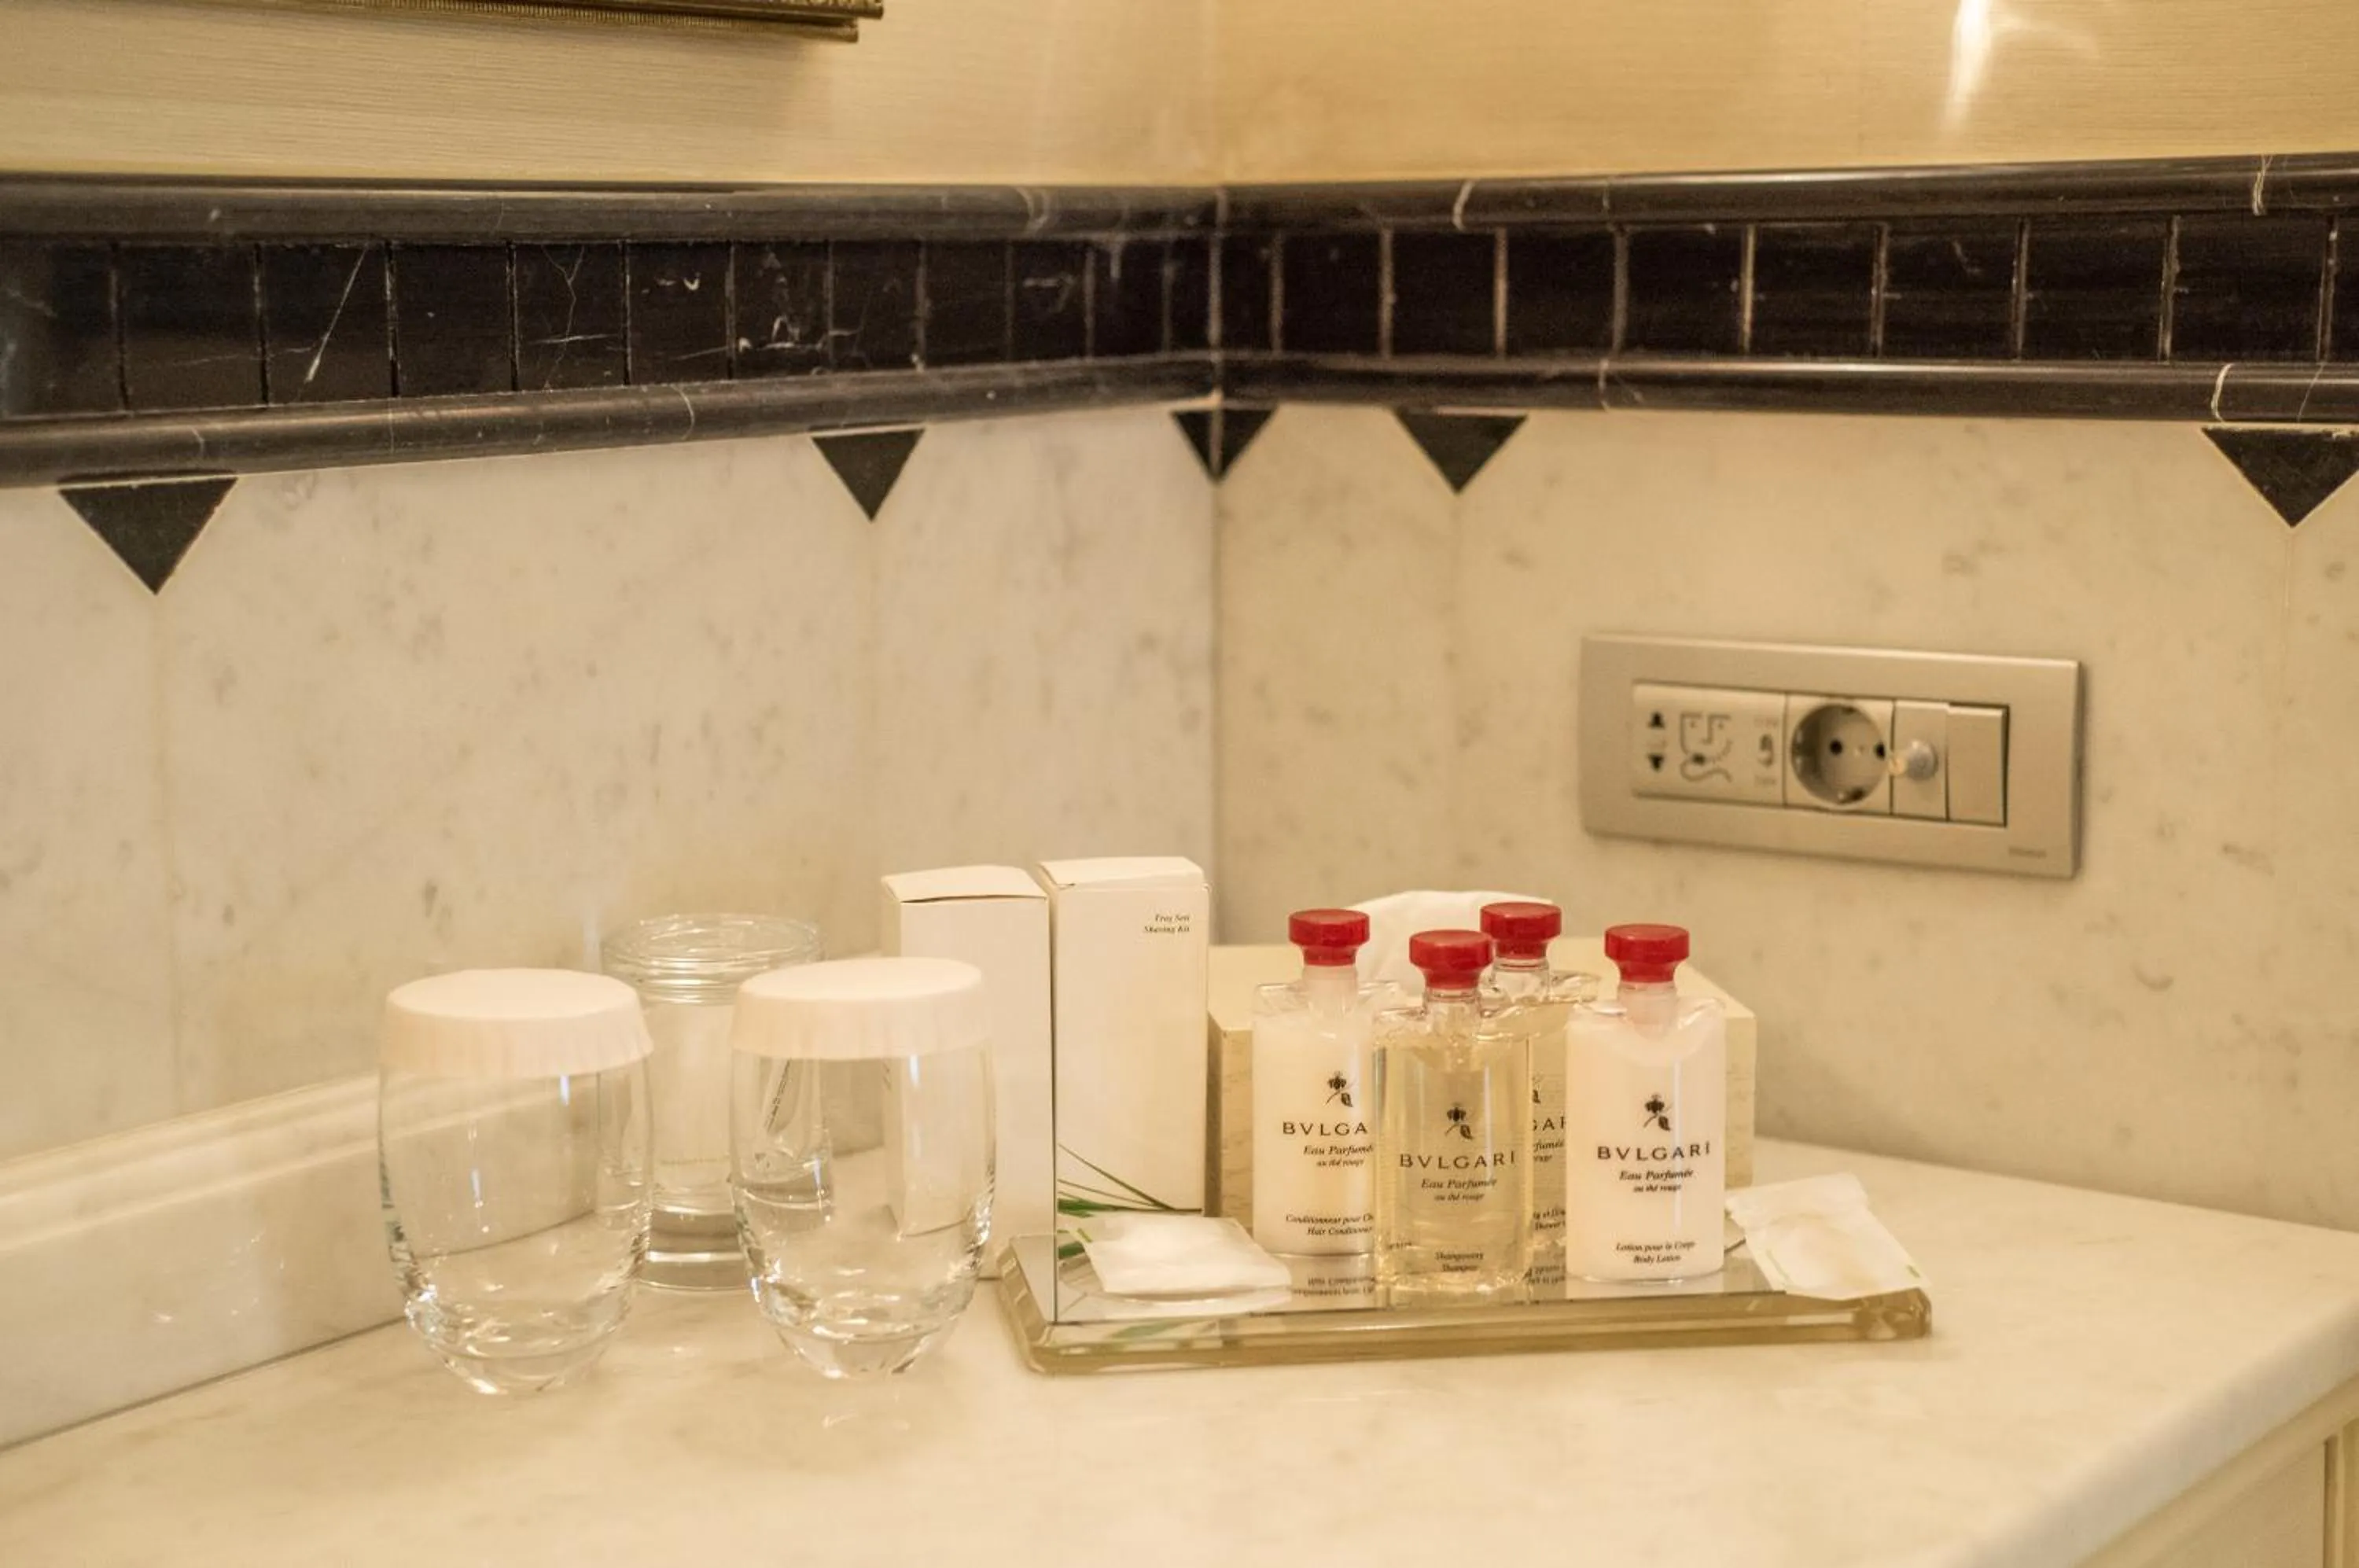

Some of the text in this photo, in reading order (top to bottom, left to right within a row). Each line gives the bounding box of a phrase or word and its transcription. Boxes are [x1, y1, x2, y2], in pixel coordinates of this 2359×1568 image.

[1283, 1121, 1367, 1136] BVLGA
[1303, 1145, 1325, 1155] Eau
[1597, 1141, 1711, 1161] BVLGARI
[1400, 1150, 1515, 1169] BVLGARI
[1619, 1170, 1641, 1180] Eau
[1422, 1179, 1444, 1189] Eau
